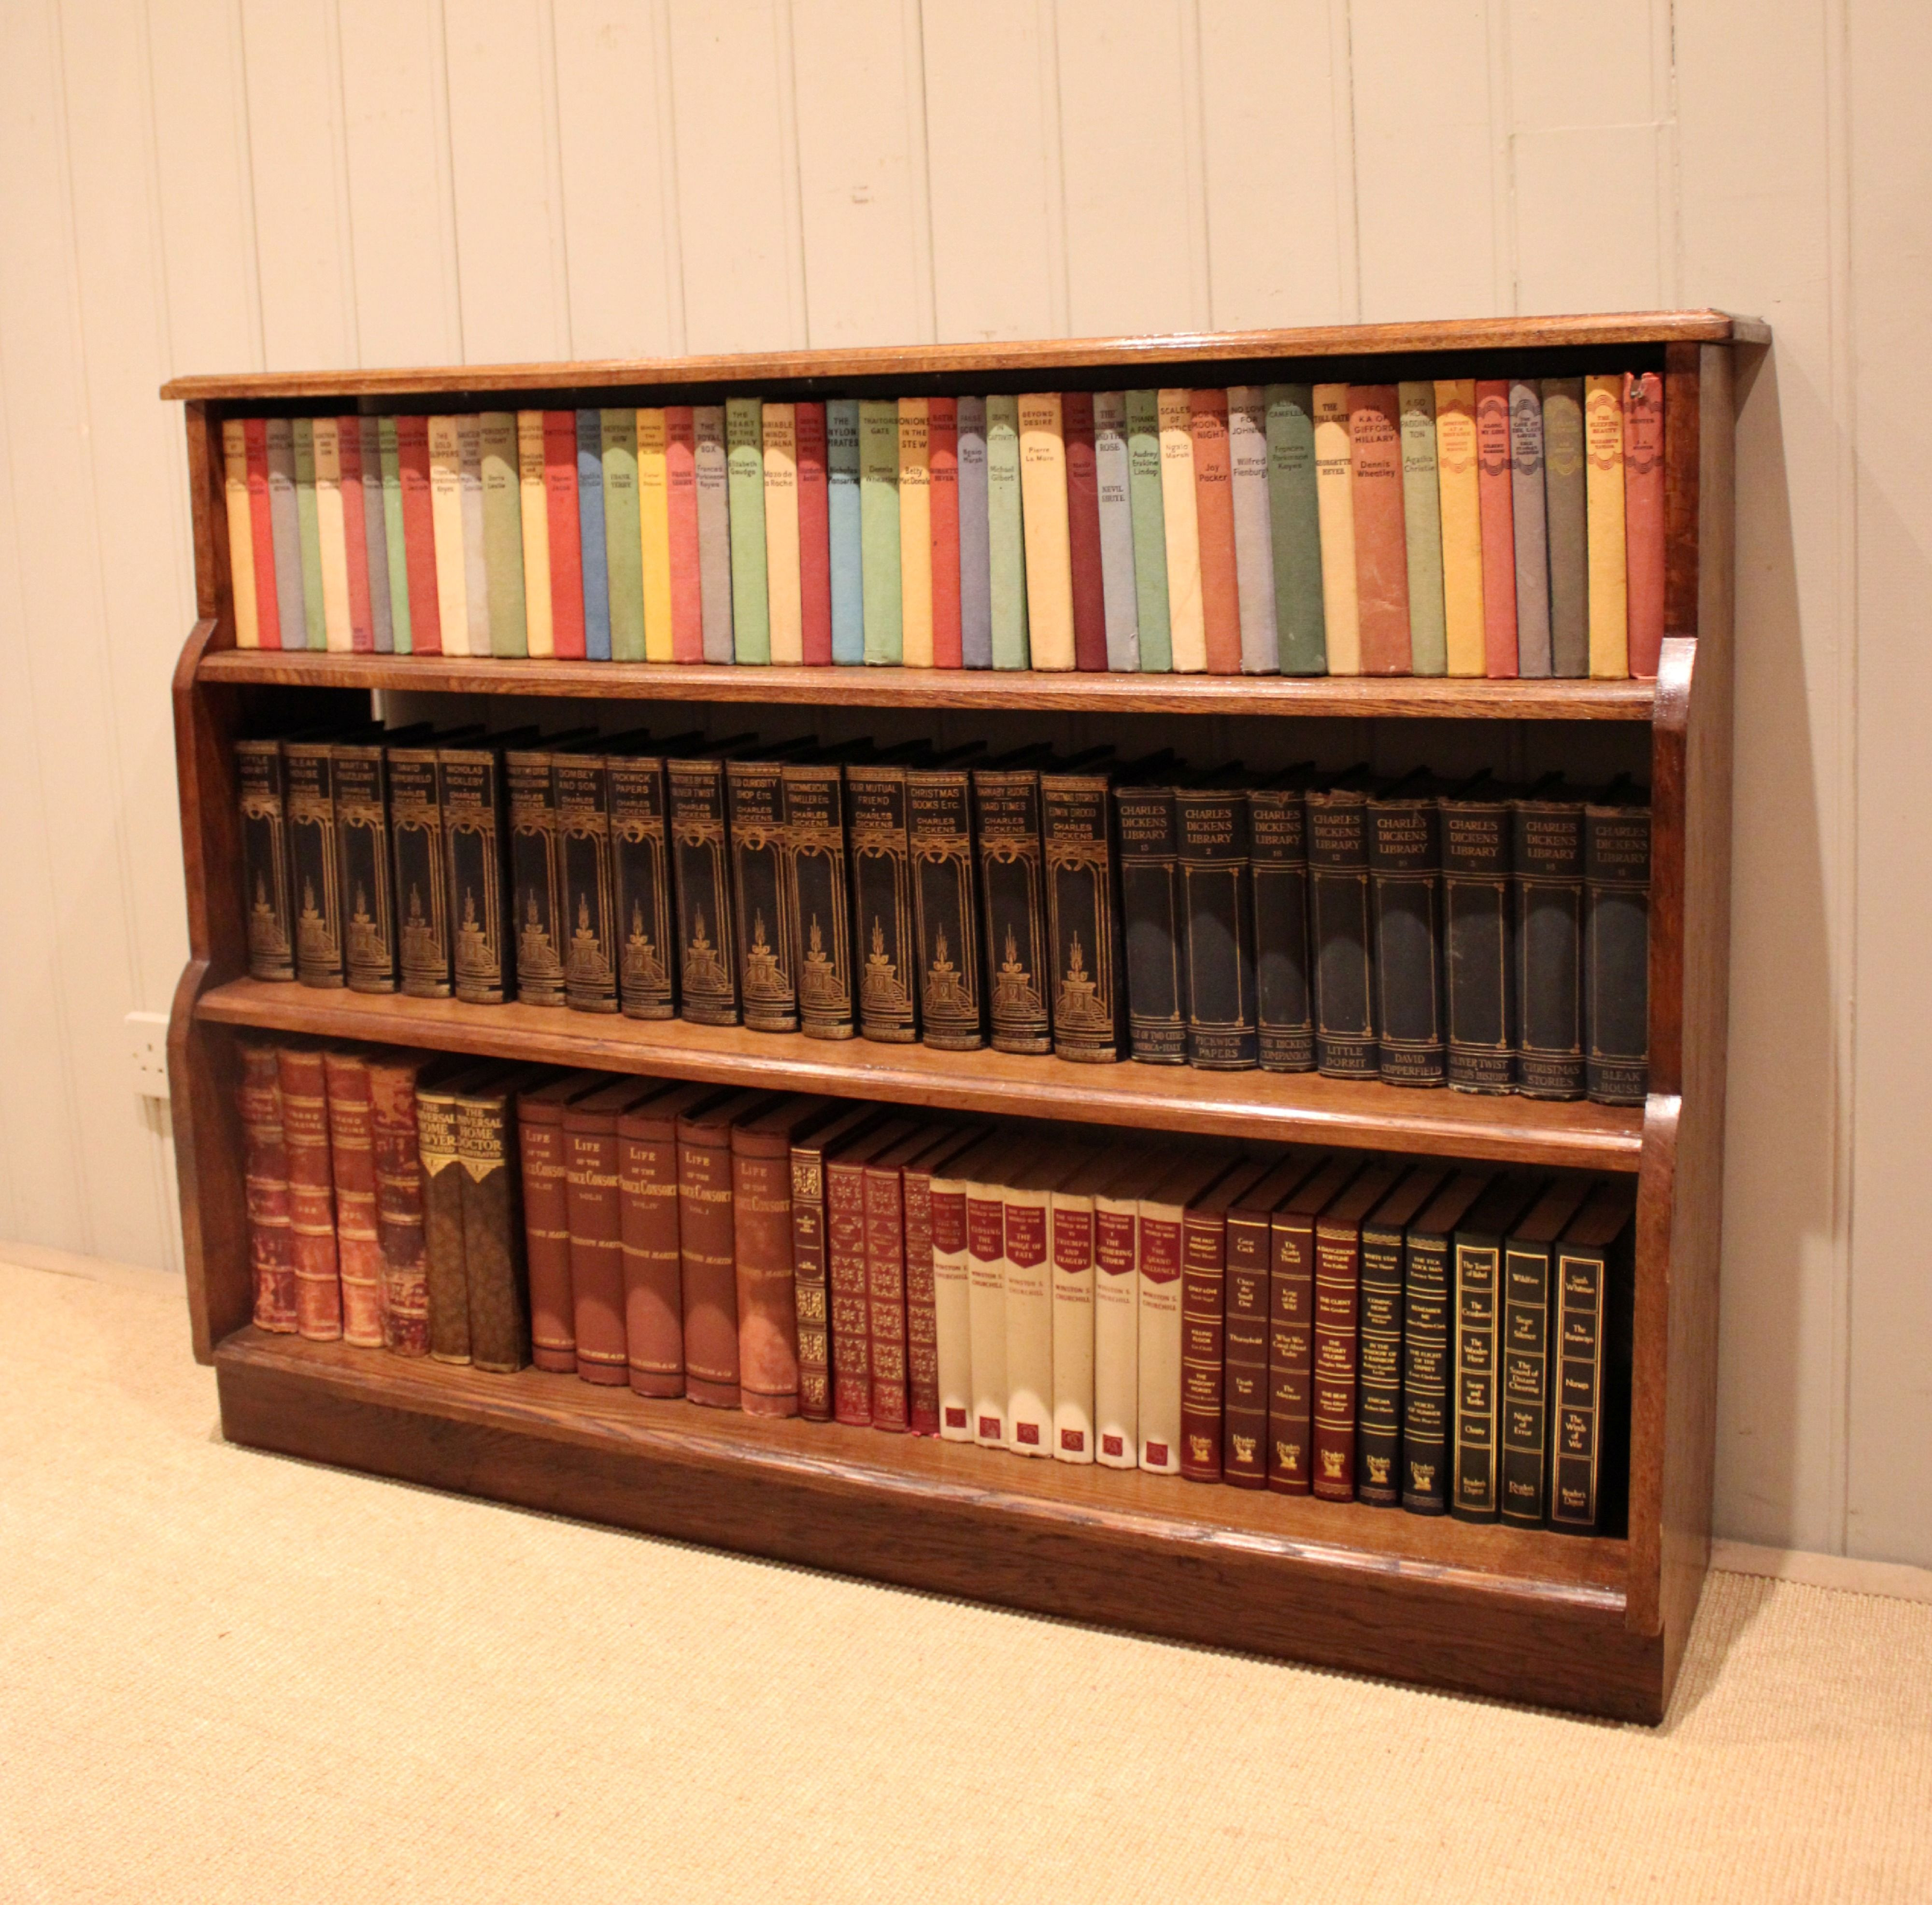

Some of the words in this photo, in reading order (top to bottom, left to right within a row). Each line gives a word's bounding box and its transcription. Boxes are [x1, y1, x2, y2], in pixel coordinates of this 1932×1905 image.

[1160, 407, 1190, 415] SCALES
[1322, 403, 1338, 411] THE
[1100, 410, 1116, 419] THE
[1197, 429, 1225, 439] NIGHT
[1354, 425, 1394, 434] GIFFORD
[902, 440, 927, 448] STEW
[1100, 443, 1121, 452] ROSE
[1406, 456, 1433, 465] Agatha
[1205, 464, 1220, 473] Joy
[1404, 465, 1435, 473] Christie
[1199, 474, 1227, 482] Packer
[446, 765, 483, 775] NICHOLAS
[578, 781, 596, 791] SON
[616, 783, 649, 794] PAPERS
[910, 788, 960, 799] CHRISTMAS
[858, 795, 890, 805] FRIEND
[677, 803, 710, 811] CHARLES
[1120, 805, 1167, 816] CHARLES
[855, 811, 893, 820] CHARLES
[1185, 809, 1232, 819] CHARLES
[1254, 810, 1301, 820] CHARLES
[917, 817, 956, 826] CHARLES
[1122, 818, 1167, 828] DICKENS
[1313, 815, 1360, 824] CHARLES
[1377, 818, 1426, 828] CHARLES
[918, 825, 956, 834] DICKENS
[1053, 822, 1093, 831] CHARLES
[1186, 821, 1233, 831] DICKENS
[1255, 822, 1302, 832] DICKENS
[1449, 820, 1498, 831] CHARLES
[1526, 821, 1577, 833] CHARLES
[1053, 832, 1094, 840] DICKENS
[1122, 830, 1168, 840] LIBRARY
[1315, 827, 1361, 837] DICKENS
[1378, 831, 1428, 841] DICKENS
[1595, 826, 1648, 837] CHARLES
[1187, 833, 1234, 844] LIBRARY
[1255, 834, 1302, 846] LIBRARY
[1450, 832, 1498, 843] DICKENS
[1527, 834, 1577, 846] DICKENS
[1316, 839, 1361, 850] LIBRARY
[1378, 843, 1428, 854] LIBRARY
[1595, 839, 1648, 850] DICKENS
[1451, 845, 1499, 857] LIBRARY
[1527, 847, 1577, 860] LIBRARY
[1596, 852, 1648, 864] LIBRARY
[1195, 1036, 1242, 1046] PICKWICK
[1198, 1048, 1239, 1058] PAPERS
[1326, 1045, 1364, 1056] LITTLE
[1326, 1057, 1366, 1068] DORRIT
[1394, 1053, 1425, 1064] DAVID
[1381, 1063, 1442, 1076] COPPERFIELD
[1522, 1061, 1580, 1074] CHRISTMAS
[1527, 1074, 1574, 1087] STORIES
[1602, 1070, 1641, 1082] BLEAK
[1600, 1082, 1641, 1094] HOUSE
[465, 1108, 483, 1117] THE
[460, 1126, 493, 1140] HOME
[575, 1139, 601, 1153] LIFE
[630, 1147, 656, 1162] LIFE
[686, 1151, 711, 1167] LIFE
[741, 1162, 768, 1178] LIFE
[978, 1235, 992, 1244] THE
[1016, 1232, 1031, 1242] THE
[1055, 1237, 1089, 1247] TRIUMPH
[1106, 1238, 1120, 1247] THE
[1101, 1255, 1126, 1266] STORM
[1512, 1273, 1539, 1285] Wildfire
[1330, 1298, 1352, 1306] CLIENT
[1366, 1296, 1393, 1306] COMING
[1471, 1301, 1482, 1310] The
[1369, 1304, 1389, 1312] HOME
[1573, 1324, 1586, 1334] The
[1471, 1338, 1482, 1347] The
[1517, 1360, 1531, 1369] The
[1321, 1390, 1333, 1398] THE
[1569, 1415, 1582, 1424] The
